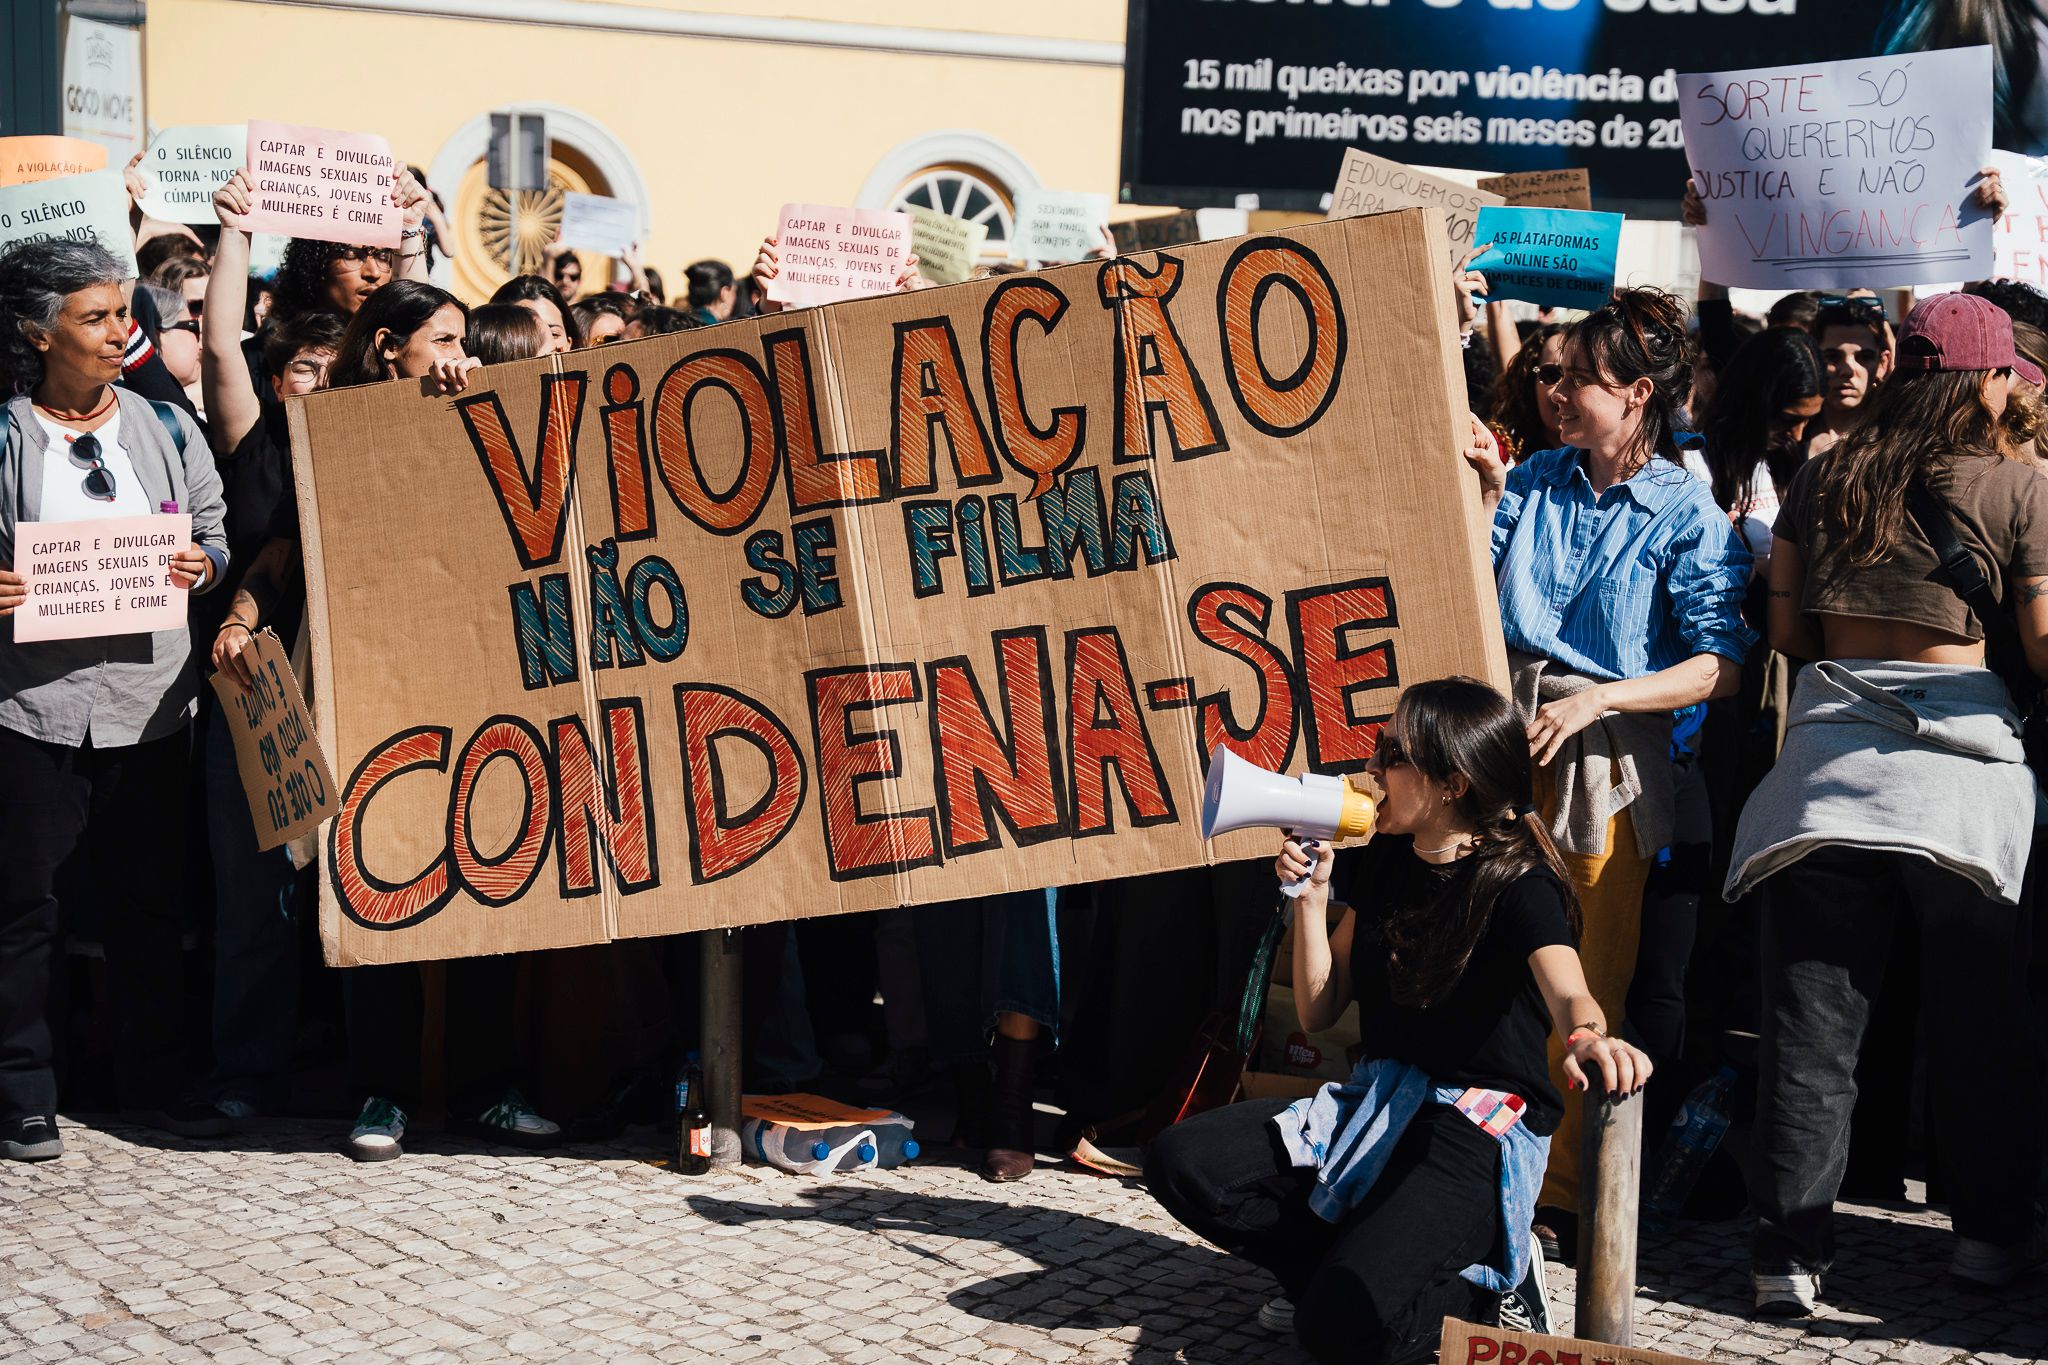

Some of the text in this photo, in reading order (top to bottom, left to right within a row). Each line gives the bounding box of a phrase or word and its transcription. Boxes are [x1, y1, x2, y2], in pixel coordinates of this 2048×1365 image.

[1183, 58, 1679, 105] 15 mil queixas por violência d
[1697, 61, 1913, 126] SORTE SÓ
[1181, 105, 1684, 149] nos primeiros seis meses de 20
[1742, 115, 1934, 161] QUERERMOS
[158, 144, 232, 160] O SILÊNCIO
[260, 139, 393, 168] CAPTAR E DIVULGAR
[17, 163, 24, 173] A
[26, 160, 76, 175] VIOLAÇÃO
[158, 170, 200, 183] TORNA
[259, 160, 391, 187] IMAGENS SEXUAIS DE
[1346, 159, 1483, 213] EDUQUEMOS
[1695, 158, 1925, 201] JUSTIÇA E NÃO
[164, 188, 216, 203] CÚMPLI
[260, 180, 388, 207] CRIANÇAS, JOVENS E
[1338, 186, 1384, 212] PARA
[1, 200, 86, 228] O SILÊNCIO
[261, 199, 384, 225] MULHERES É CRIME
[65, 225, 96, 242] NOS
[787, 218, 902, 241] CAPTAR E DIVULGAR
[1492, 231, 1599, 251] AS PLATAFORMAS
[1735, 203, 1962, 258] VINGANÇA
[785, 236, 900, 258] IMAGENS SEXUAIS DE
[785, 253, 896, 276] CRIANÇAS, JOVENS E
[1504, 252, 1578, 272] ONLINE SÃO
[786, 271, 892, 292] MULHERES É CRIME
[1547, 277, 1563, 289] DE
[1566, 279, 1605, 294] CRIME
[32, 534, 176, 555] CAPTAR E DIVULGAR
[32, 554, 175, 576] IMAGENS SEXUAIS DE
[34, 574, 171, 597] CRIANÇAS, JOVENS E
[38, 595, 168, 617] MULHERES É CRIME
[508, 537, 689, 688] NÃO
[741, 515, 844, 619] SE
[329, 576, 1400, 932] CONDENA-SE
